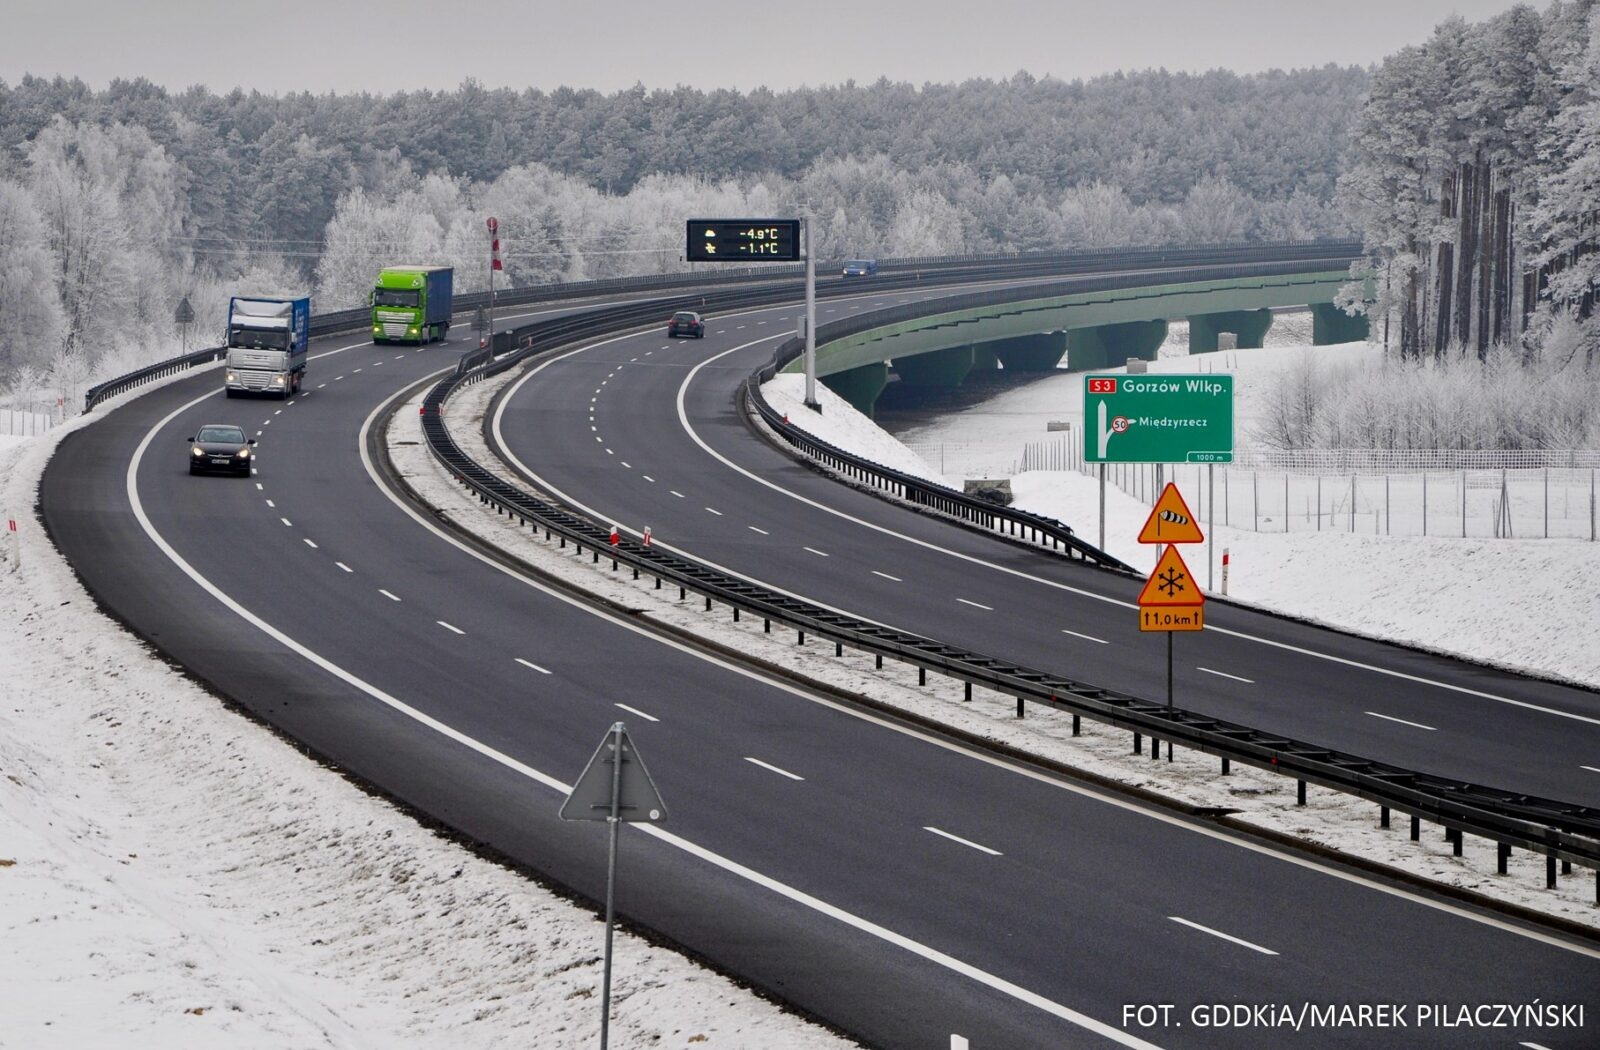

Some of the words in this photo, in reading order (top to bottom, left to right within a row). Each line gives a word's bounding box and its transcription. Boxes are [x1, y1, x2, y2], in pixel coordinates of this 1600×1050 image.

[1122, 379, 1180, 393] Gorzów
[1186, 379, 1227, 397] Wlkp.
[1114, 420, 1126, 429] 50
[1139, 416, 1208, 429] Międzyrzecz
[1153, 612, 1172, 626] 1,0
[1174, 614, 1191, 625] km
